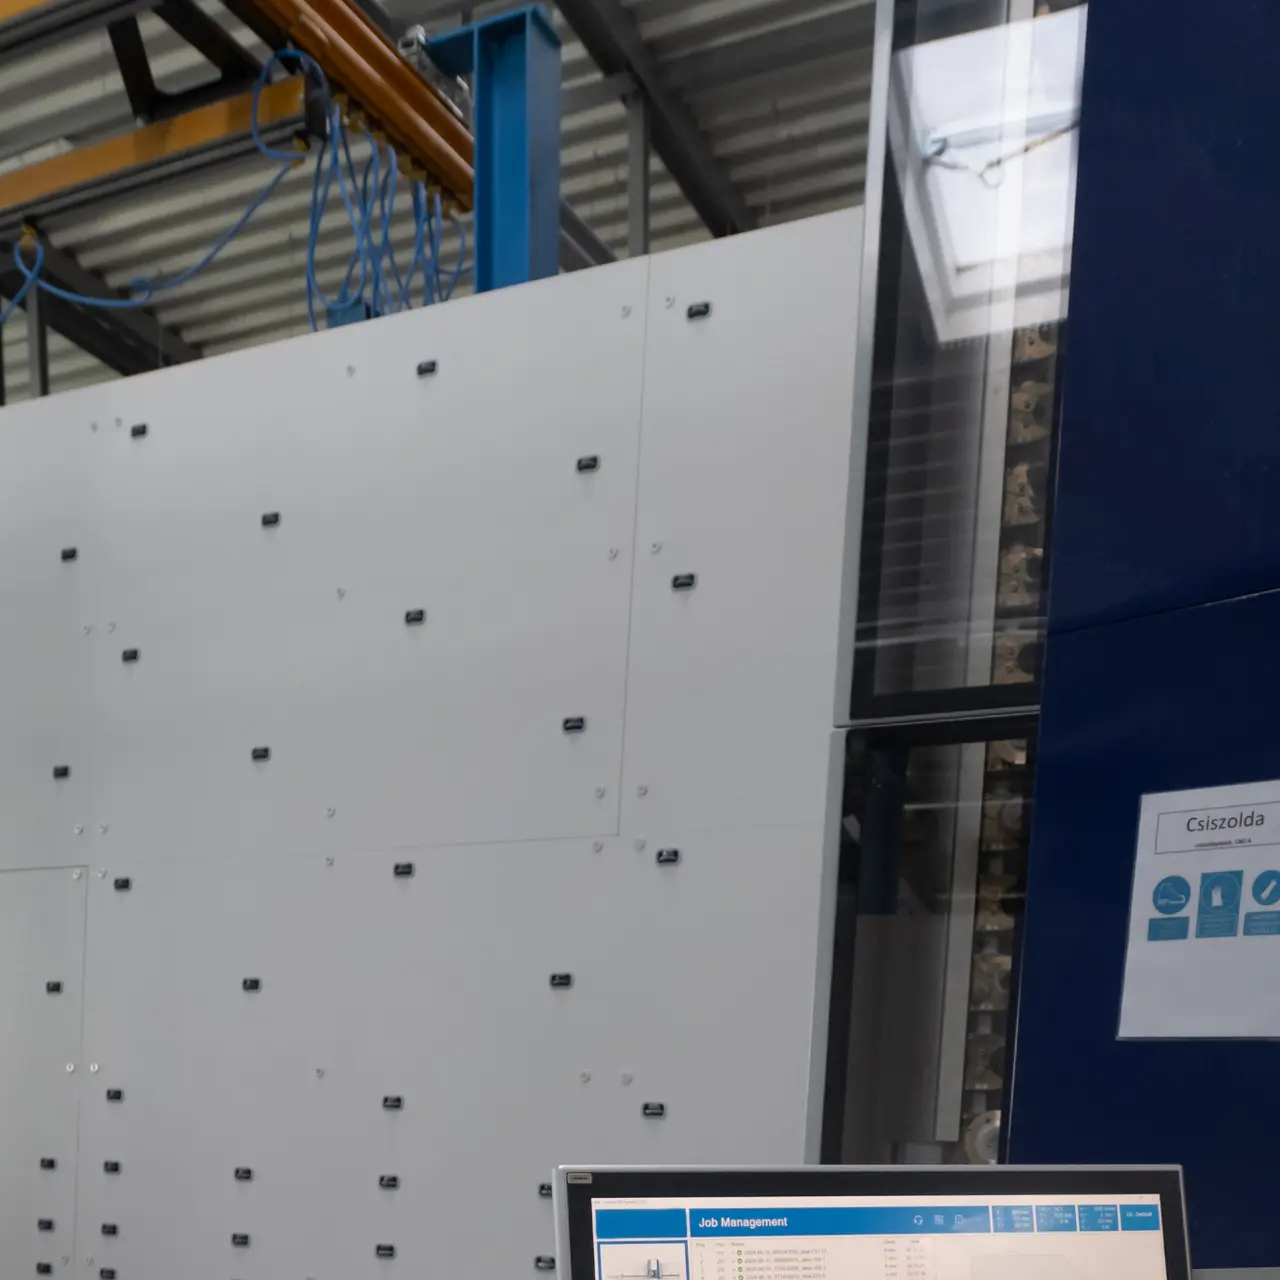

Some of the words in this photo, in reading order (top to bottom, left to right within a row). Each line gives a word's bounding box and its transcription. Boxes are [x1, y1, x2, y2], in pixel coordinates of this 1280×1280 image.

[1186, 810, 1265, 832] Csiszolda
[699, 1217, 718, 1227] Job
[721, 1217, 787, 1229] Management
